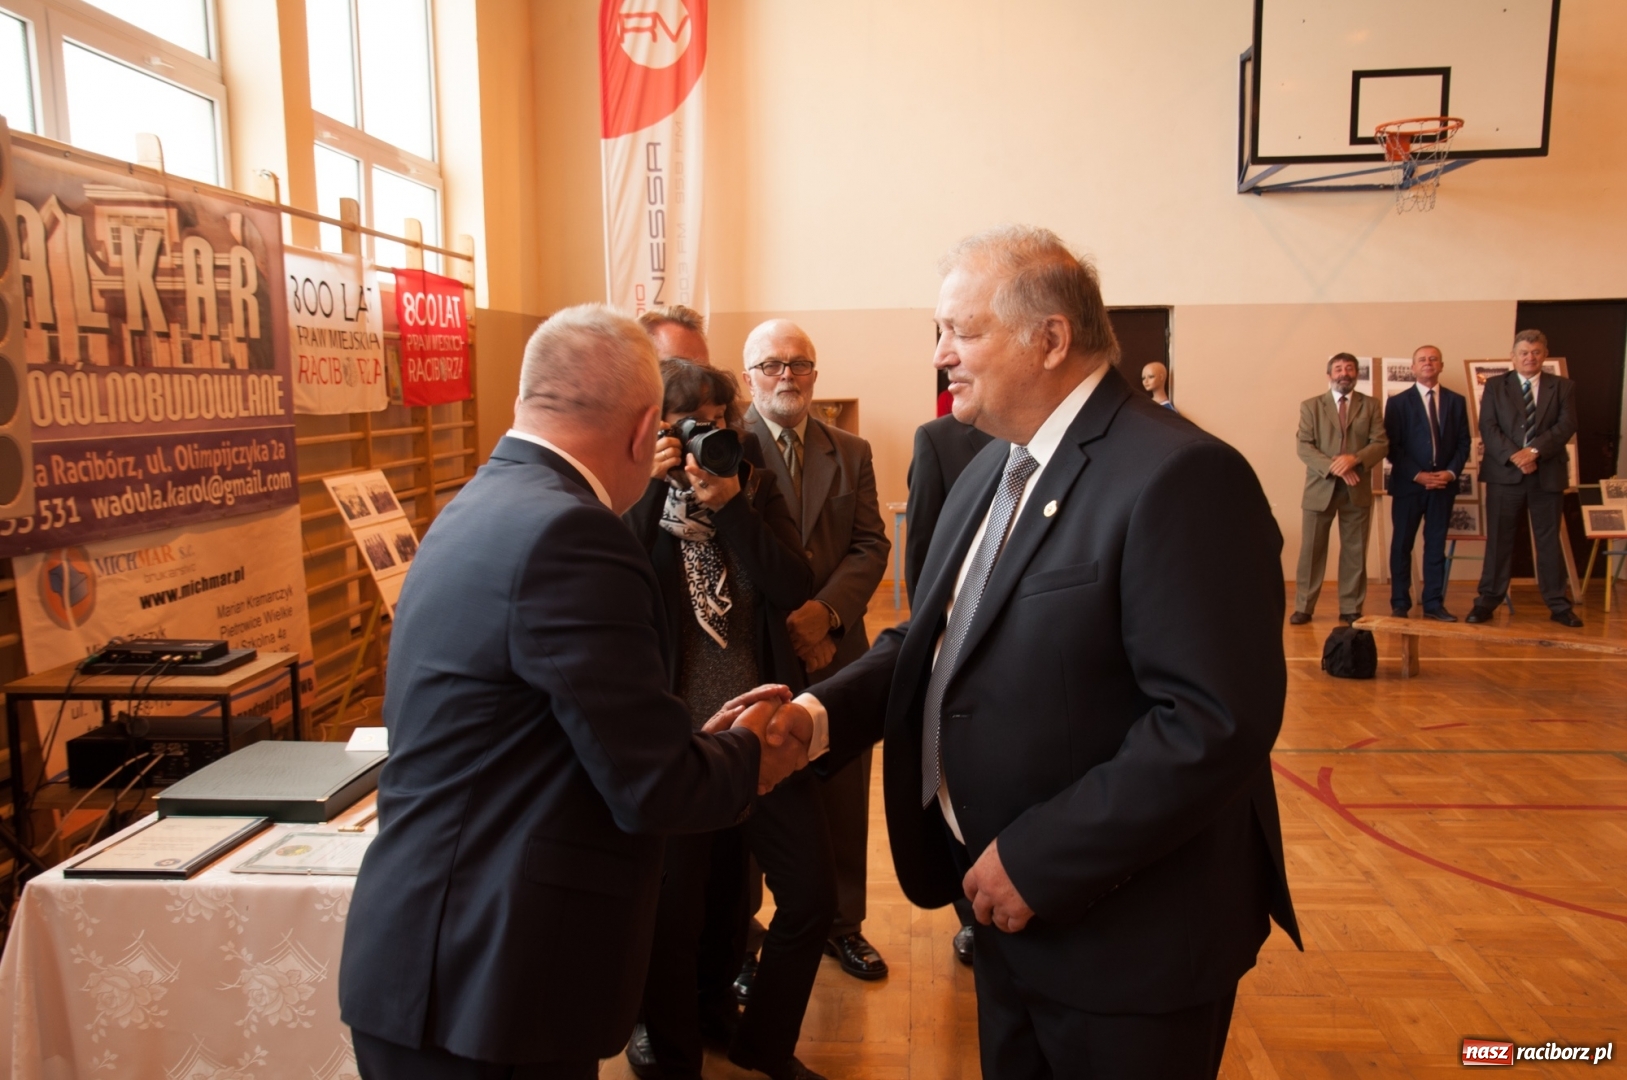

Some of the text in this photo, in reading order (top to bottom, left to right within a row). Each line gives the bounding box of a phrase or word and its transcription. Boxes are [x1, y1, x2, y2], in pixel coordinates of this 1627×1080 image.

[646, 142, 666, 305] NESSA
[403, 292, 461, 328] 800 LAT
[28, 362, 285, 428] OGÓLNOBUDOWLANE
[51, 450, 143, 485] Racibórz,
[146, 446, 173, 475] ul.
[175, 439, 270, 475] Olimpijczyka
[271, 439, 286, 461] 2a
[39, 496, 81, 530] 531
[91, 470, 292, 519] wadula.karol@gmail.com
[95, 544, 175, 578] MICHMAR
[139, 566, 244, 610] www.michmar.pl
